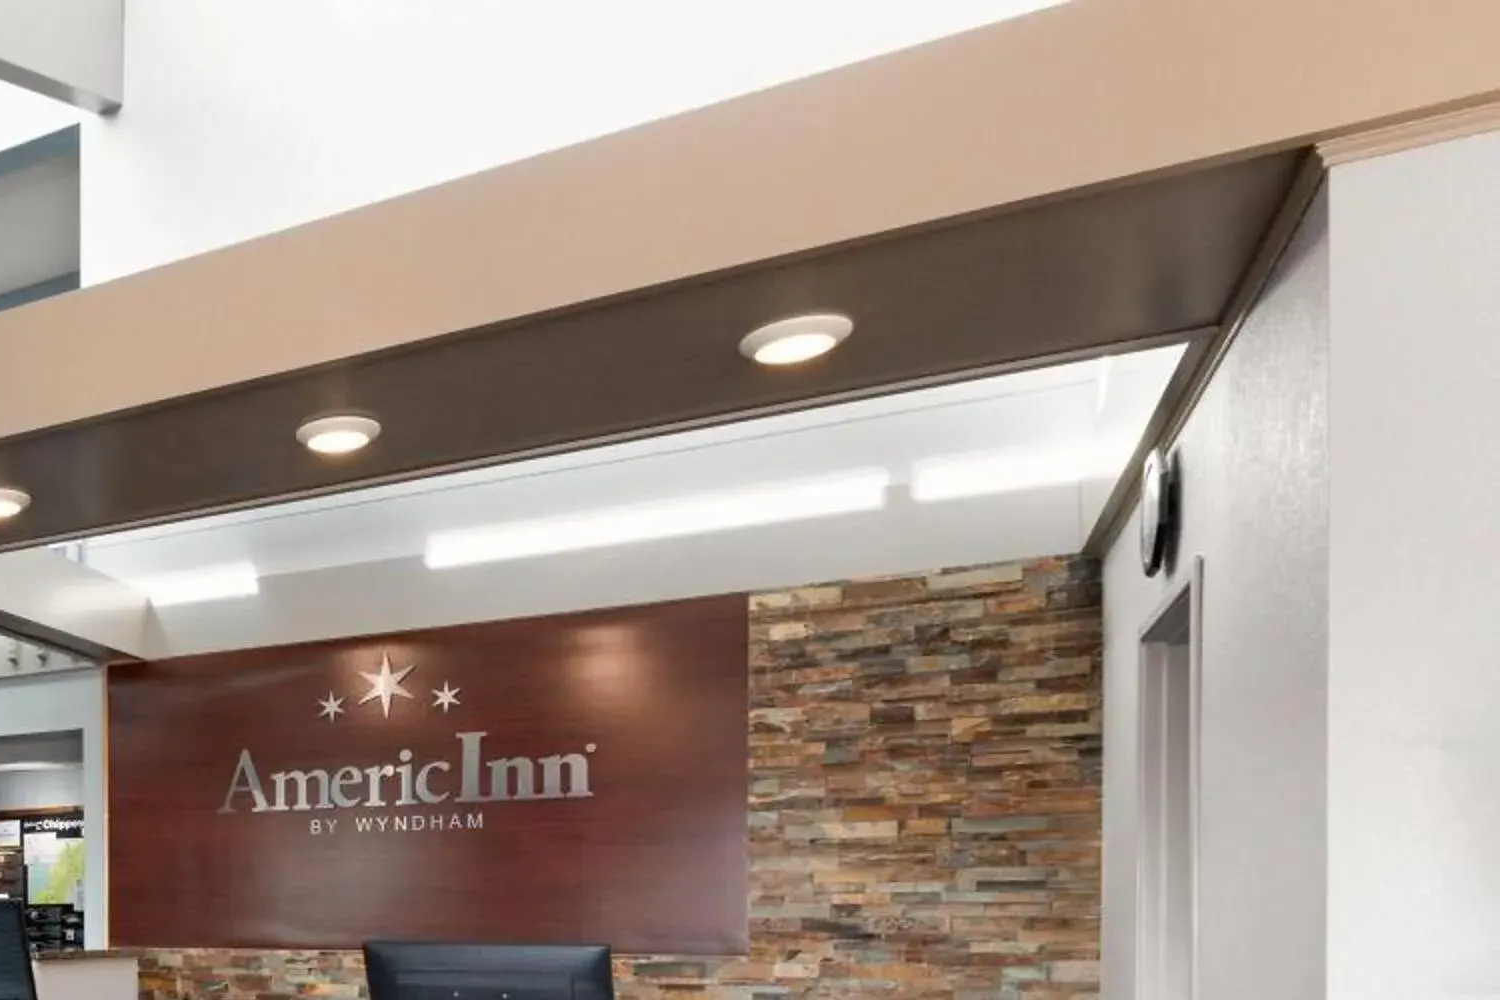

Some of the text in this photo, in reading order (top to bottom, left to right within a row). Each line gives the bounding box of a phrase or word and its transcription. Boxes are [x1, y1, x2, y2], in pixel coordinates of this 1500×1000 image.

[216, 731, 595, 815] AmericInn
[309, 812, 484, 835] BY WYNDHAM
